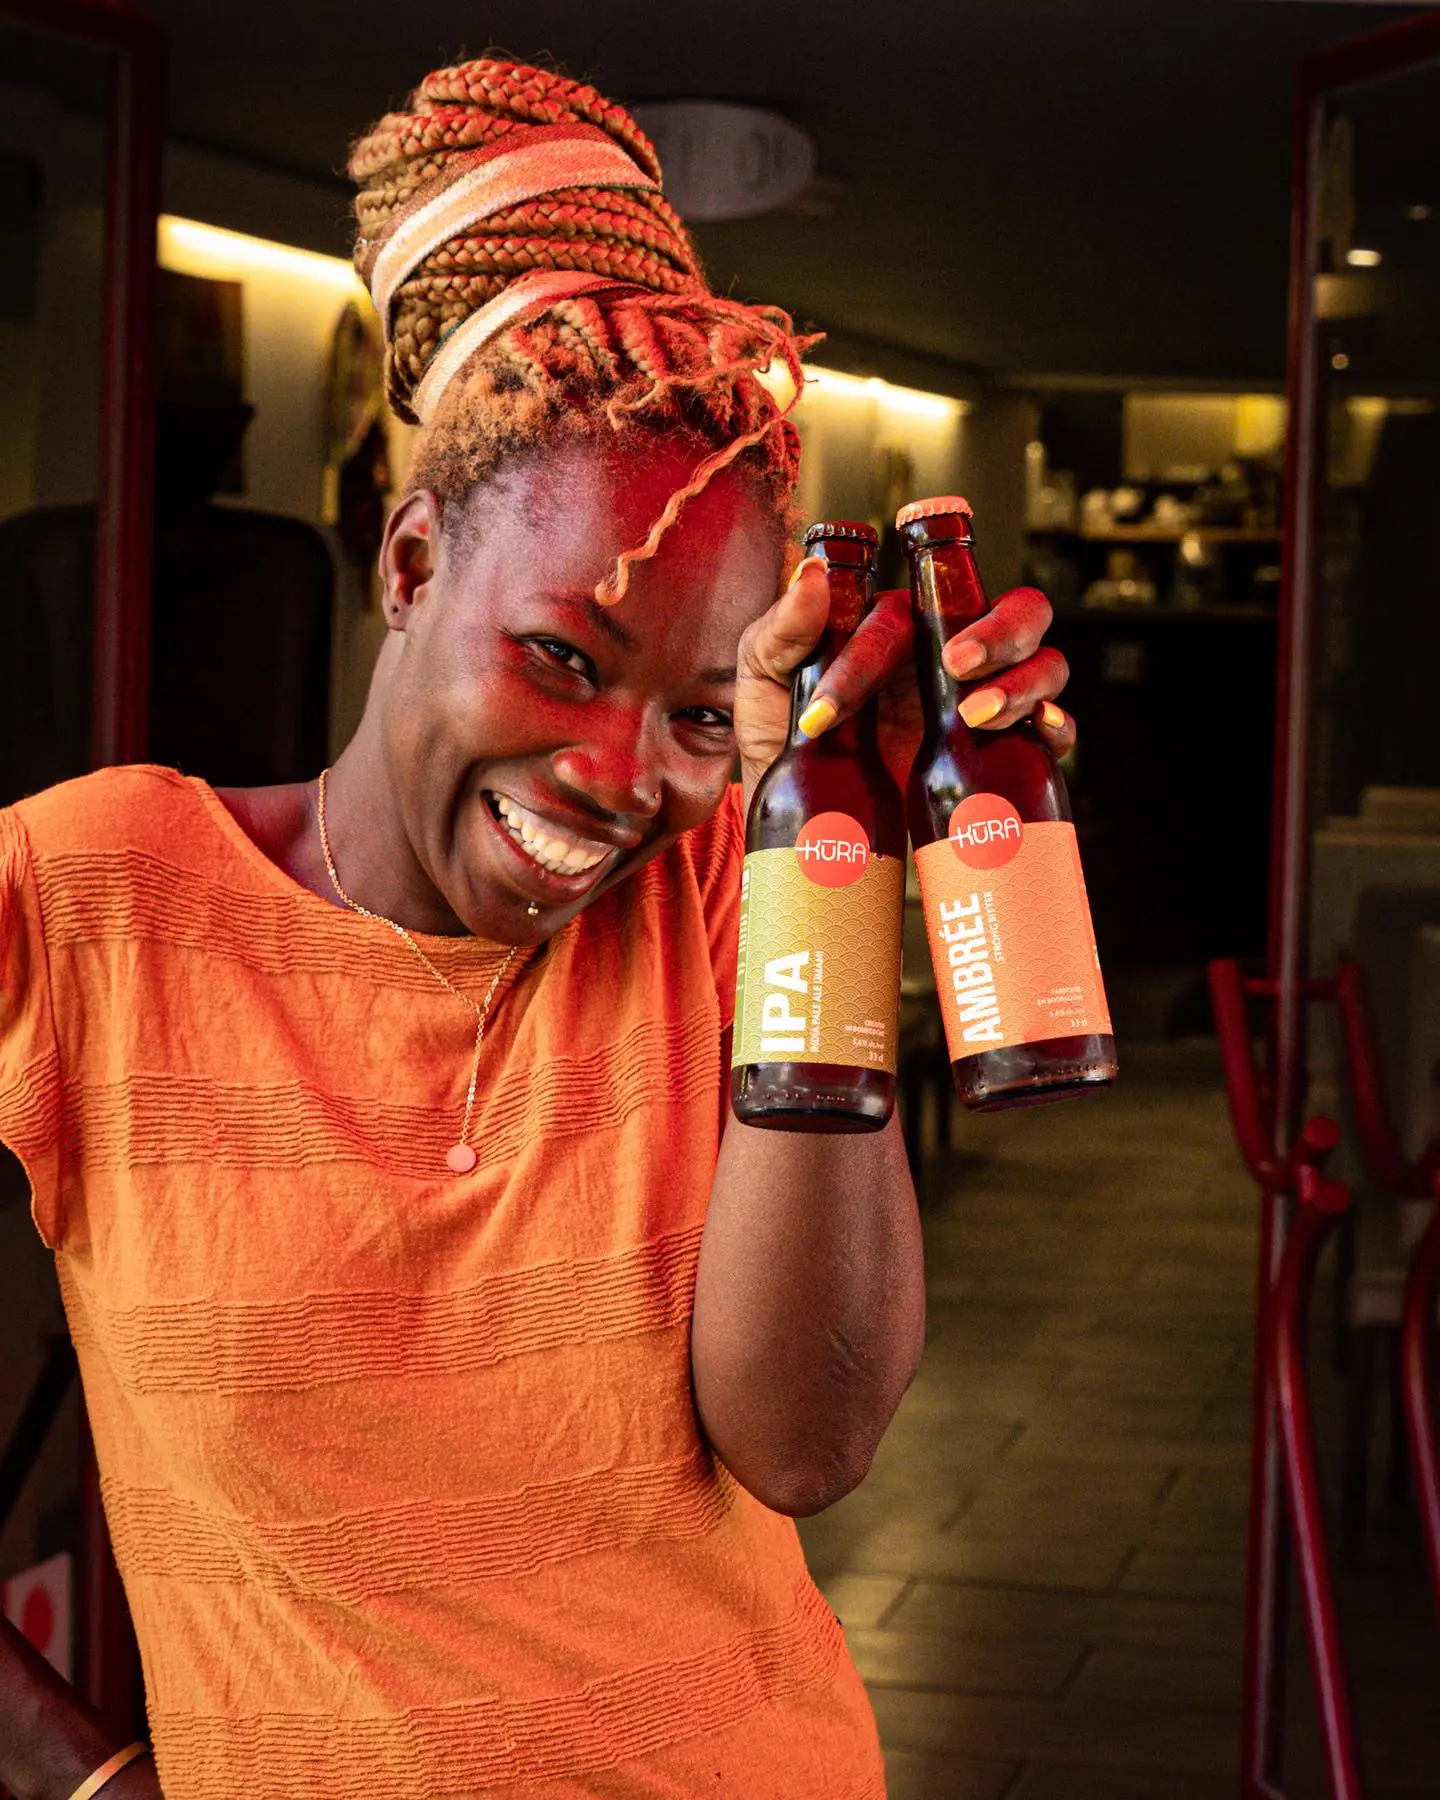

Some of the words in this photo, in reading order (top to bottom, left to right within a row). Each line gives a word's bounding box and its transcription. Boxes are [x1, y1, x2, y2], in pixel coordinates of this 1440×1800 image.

[938, 892, 1005, 1043] AMBRÉE
[760, 950, 810, 1053] IPA
[812, 984, 823, 1003] ALE
[811, 1003, 822, 1025] PALE
[809, 1027, 820, 1053] INDIA
